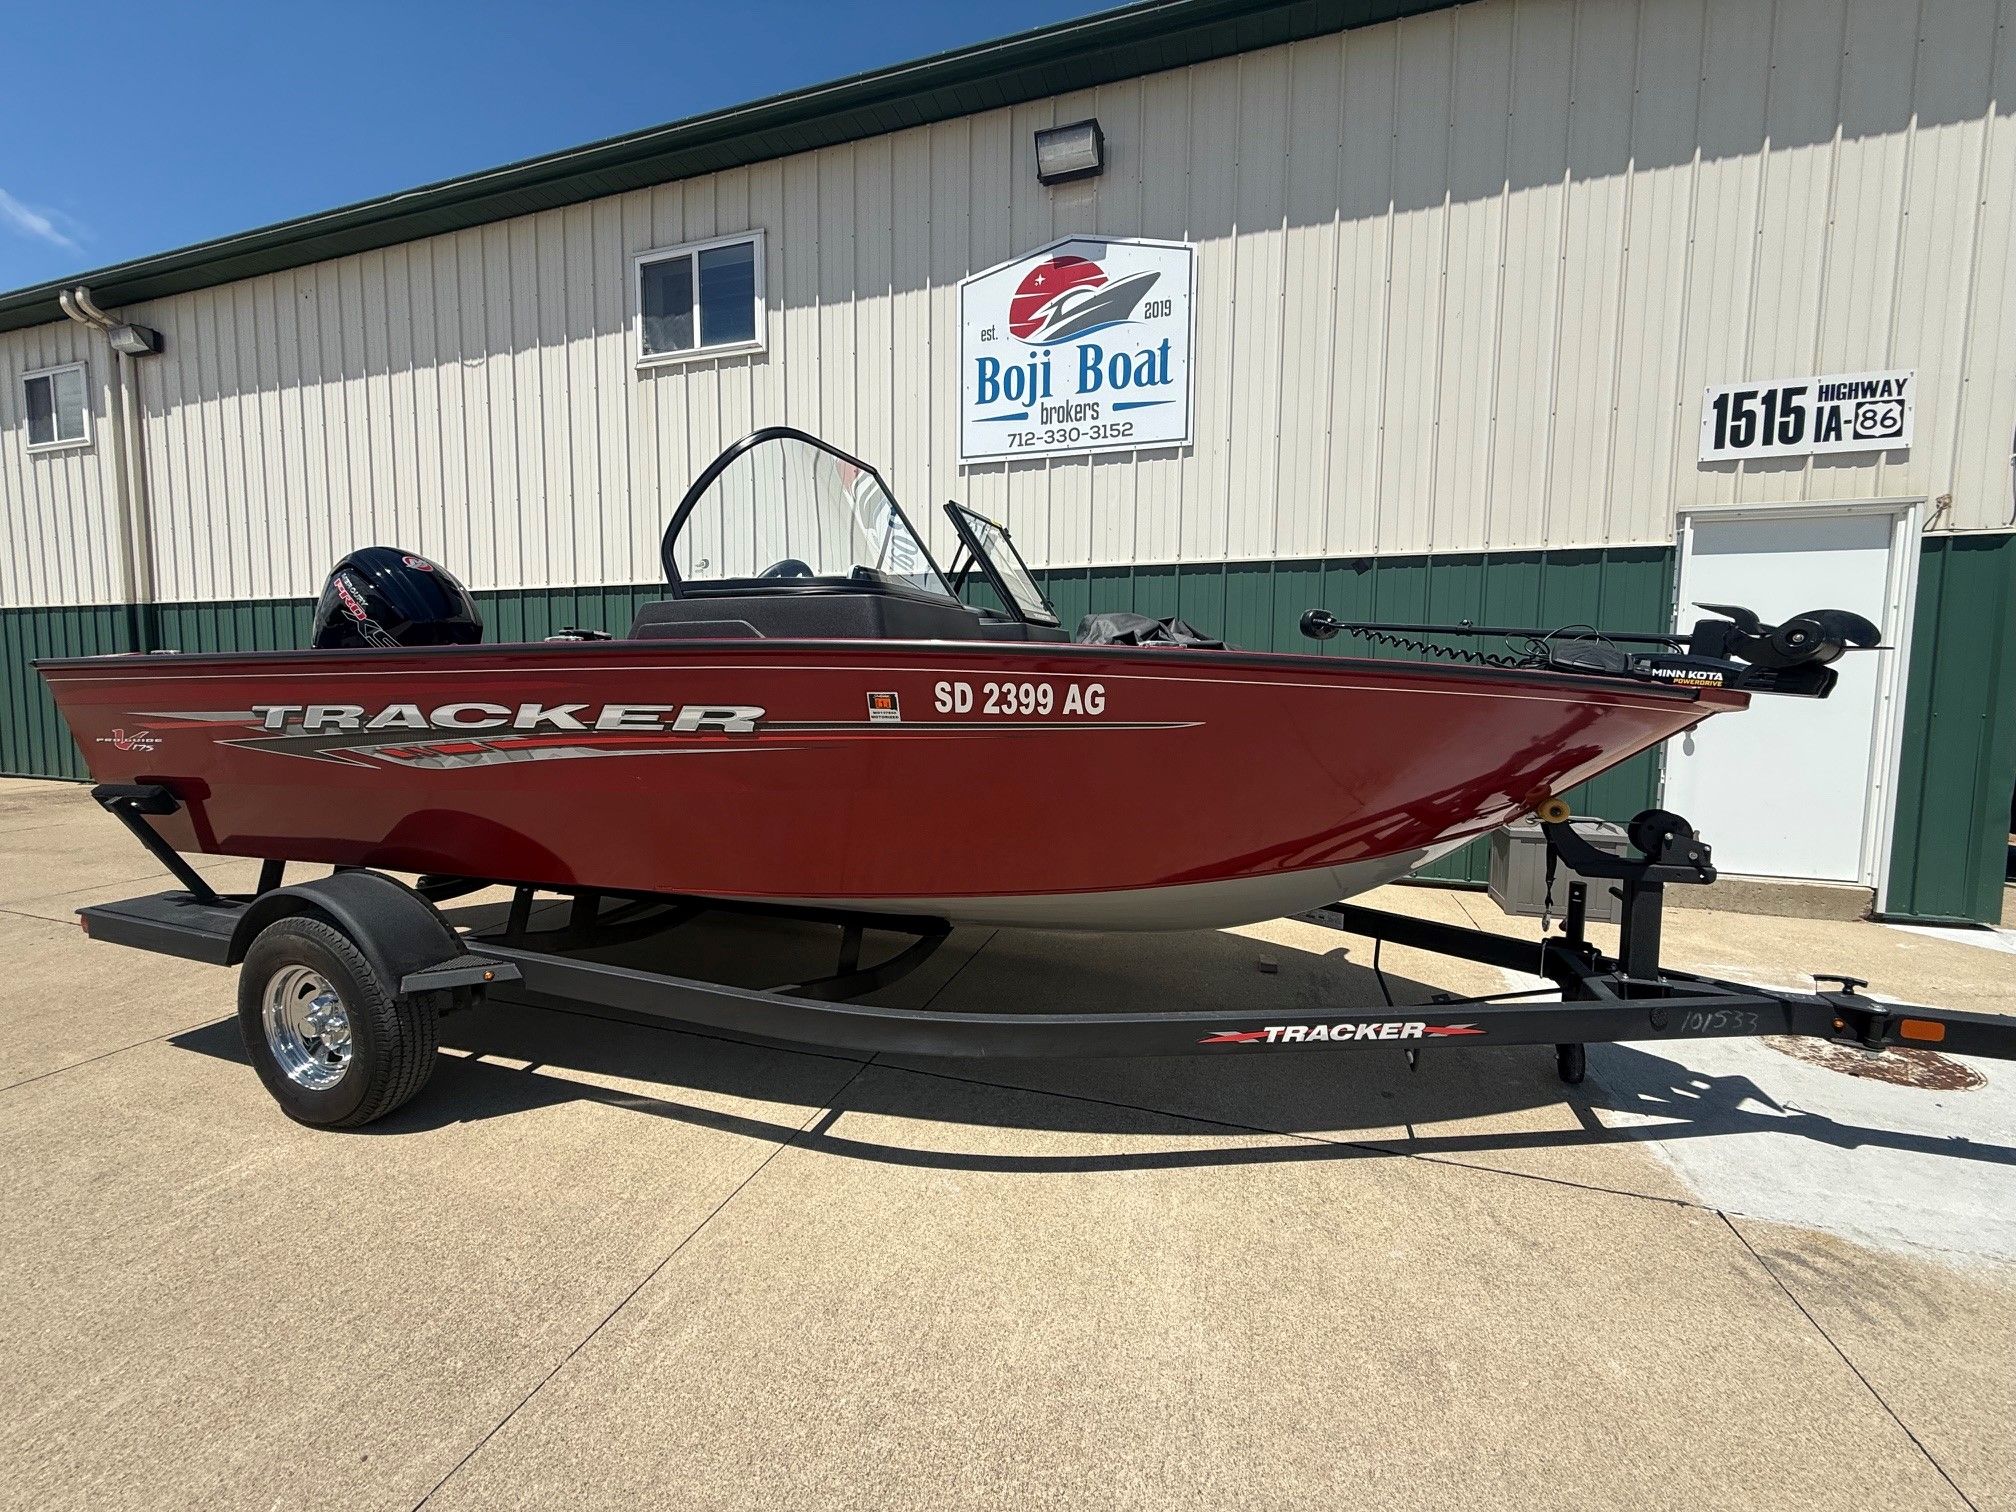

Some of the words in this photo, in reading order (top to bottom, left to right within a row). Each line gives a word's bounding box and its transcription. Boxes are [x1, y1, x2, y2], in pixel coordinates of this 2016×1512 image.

[1144, 299, 1172, 320] 2019
[980, 325, 999, 342] est.
[974, 350, 1054, 408] Boji
[1075, 338, 1174, 395] Boat
[1817, 378, 1908, 402] HIGHWAY
[1040, 400, 1100, 426] brokers
[1712, 386, 1808, 450] 1515
[1007, 422, 1134, 448] 712-330-3152
[1652, 669, 1686, 678] MINN
[1688, 671, 1723, 681] KOTA
[1673, 678, 1722, 686] POWERDRIVE
[934, 681, 974, 714] SD
[982, 682, 1054, 715] 2399
[1062, 683, 1106, 715] AG
[251, 702, 766, 733] TRACKER
[1262, 1022, 1426, 1044] TRACKER
[1681, 1009, 1759, 1035] 101533
